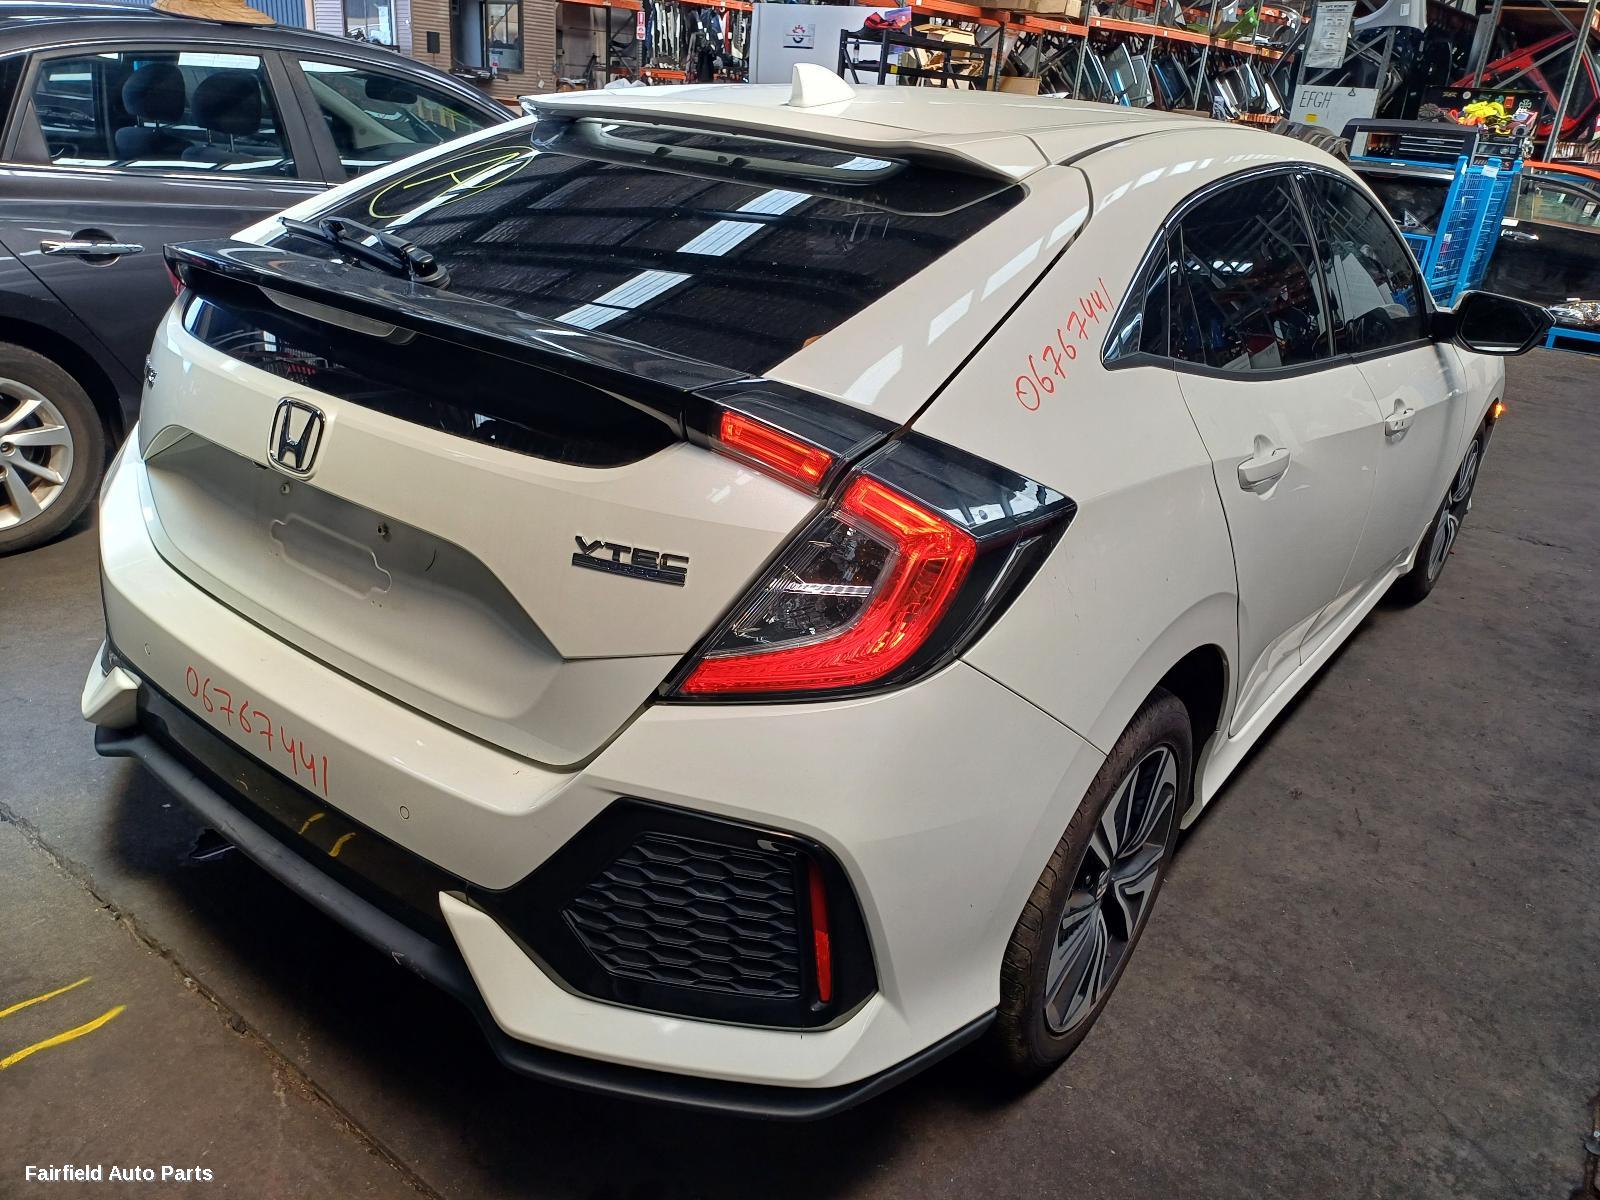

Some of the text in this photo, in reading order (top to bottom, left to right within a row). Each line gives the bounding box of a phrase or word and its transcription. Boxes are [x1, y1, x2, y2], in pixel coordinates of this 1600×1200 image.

[1299, 91, 1333, 108] EFGH
[1016, 277, 1115, 411] 06767441
[574, 535, 689, 574] VTEC
[186, 665, 328, 797] 06767441
